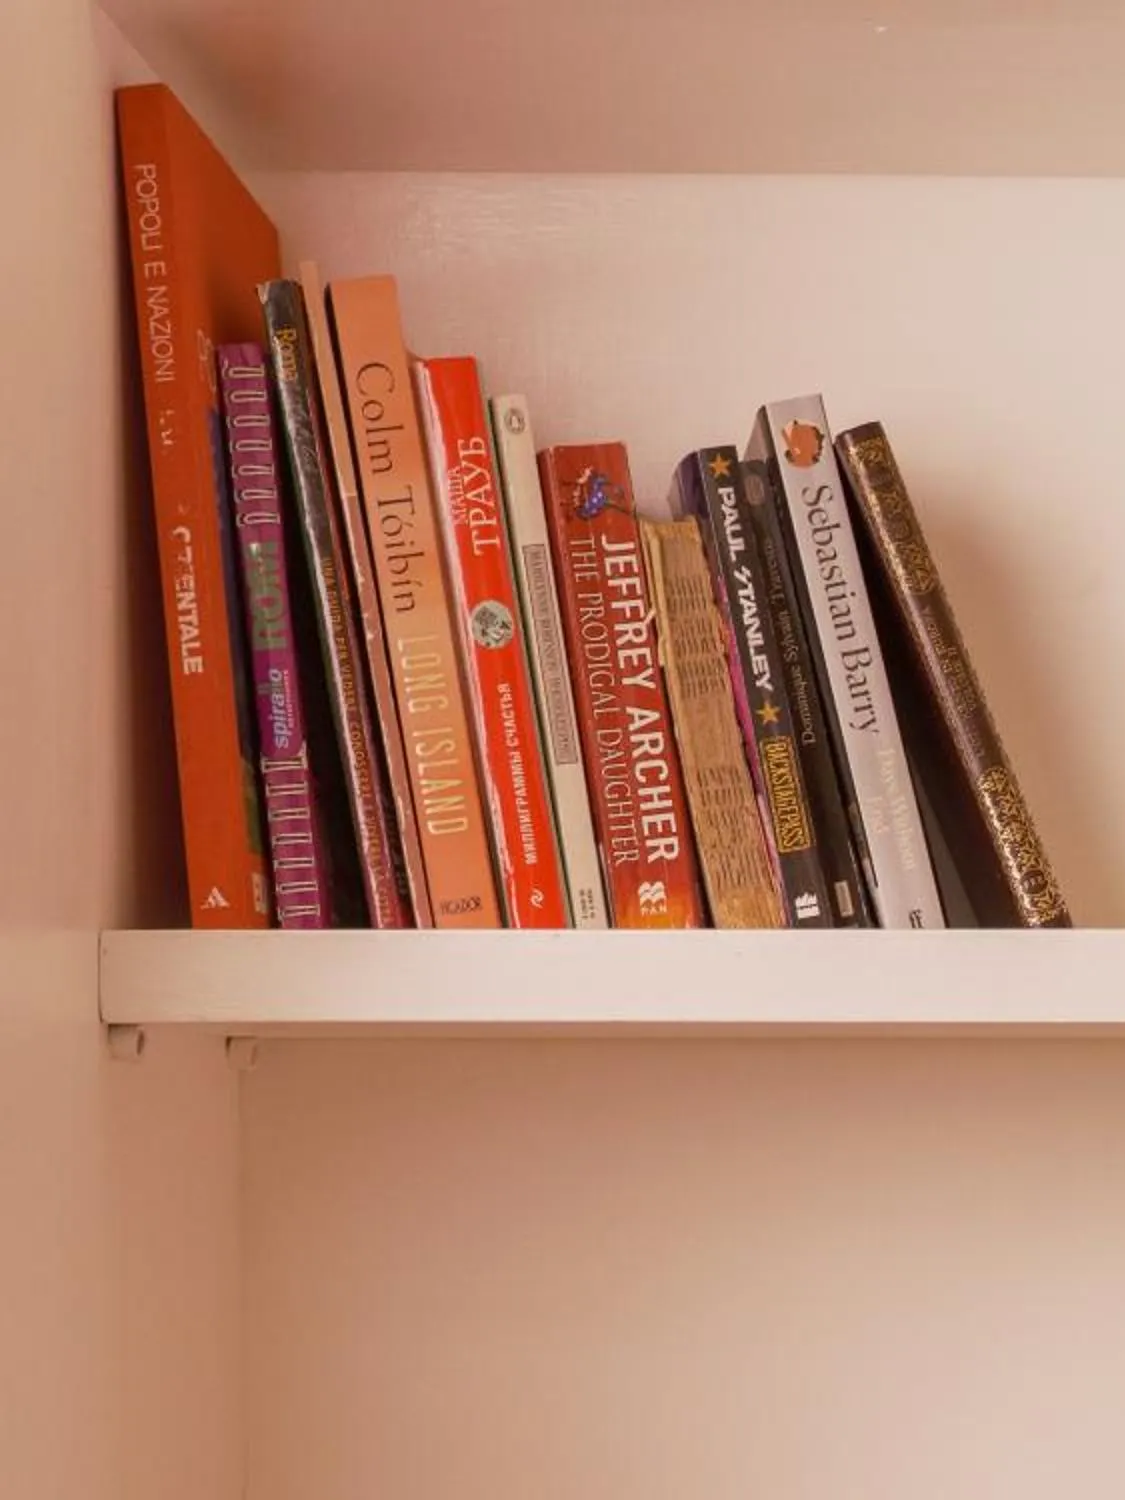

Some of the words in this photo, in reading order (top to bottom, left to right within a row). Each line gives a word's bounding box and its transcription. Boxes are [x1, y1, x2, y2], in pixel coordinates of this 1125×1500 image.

[136, 164, 162, 251] POPOLI
[144, 262, 166, 278] E
[147, 284, 175, 382] NAZIONI
[356, 362, 404, 474] Colm
[377, 485, 427, 613] Tóibín
[458, 436, 501, 556] ТРАУБ
[570, 536, 600, 583] THE
[601, 532, 656, 689] JEFFREY
[718, 487, 746, 562] PAUL
[733, 566, 774, 692] STANLEY
[801, 484, 859, 642] Sebastian
[840, 645, 881, 733] Barry
[398, 633, 447, 714] LONG
[577, 592, 621, 718] PRODIGAL
[412, 727, 468, 836] ISLAND
[597, 729, 641, 866] DAUGHTER
[626, 706, 680, 863] ARCHER
